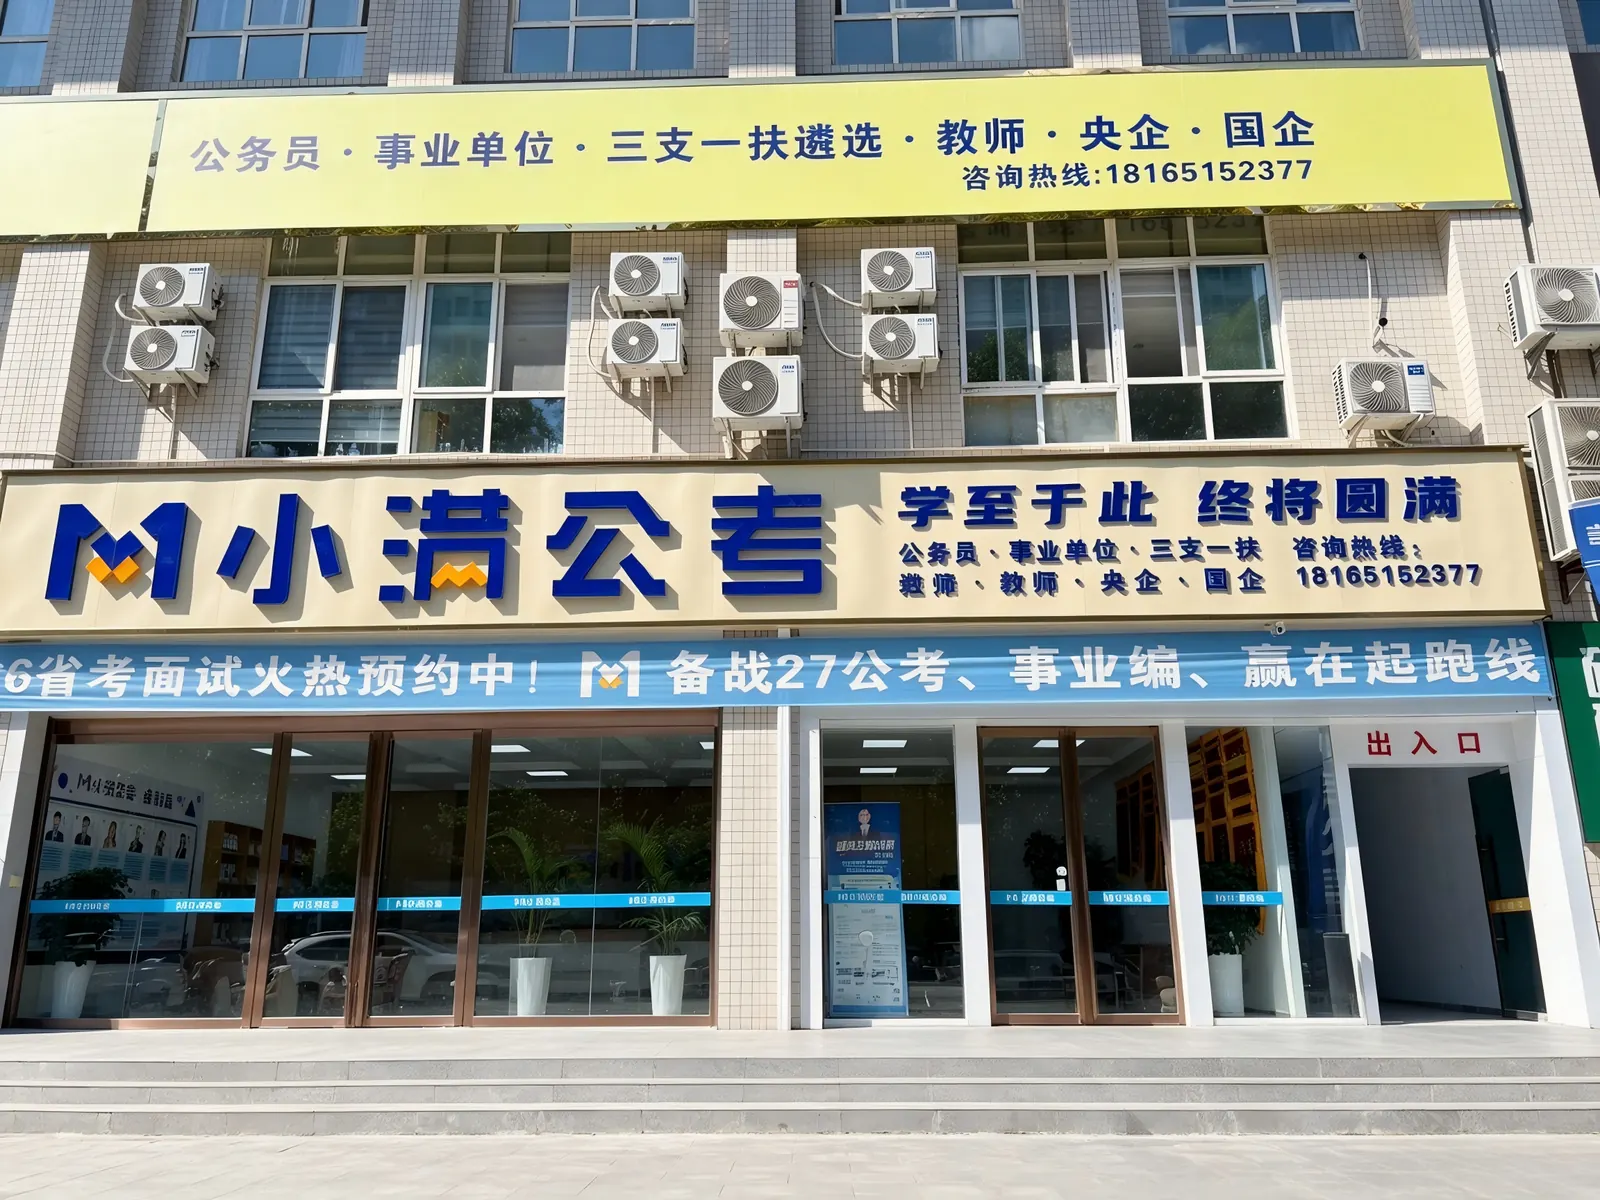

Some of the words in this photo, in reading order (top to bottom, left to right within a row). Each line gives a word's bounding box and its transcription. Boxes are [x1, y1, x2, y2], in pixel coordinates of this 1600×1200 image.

[897, 481, 1154, 529] 学至于此
[1197, 475, 1460, 524] 终将圆满
[217, 485, 823, 606] 小满公考
[1296, 563, 1480, 587] 18165152377
[1367, 731, 1481, 756] 出入口
